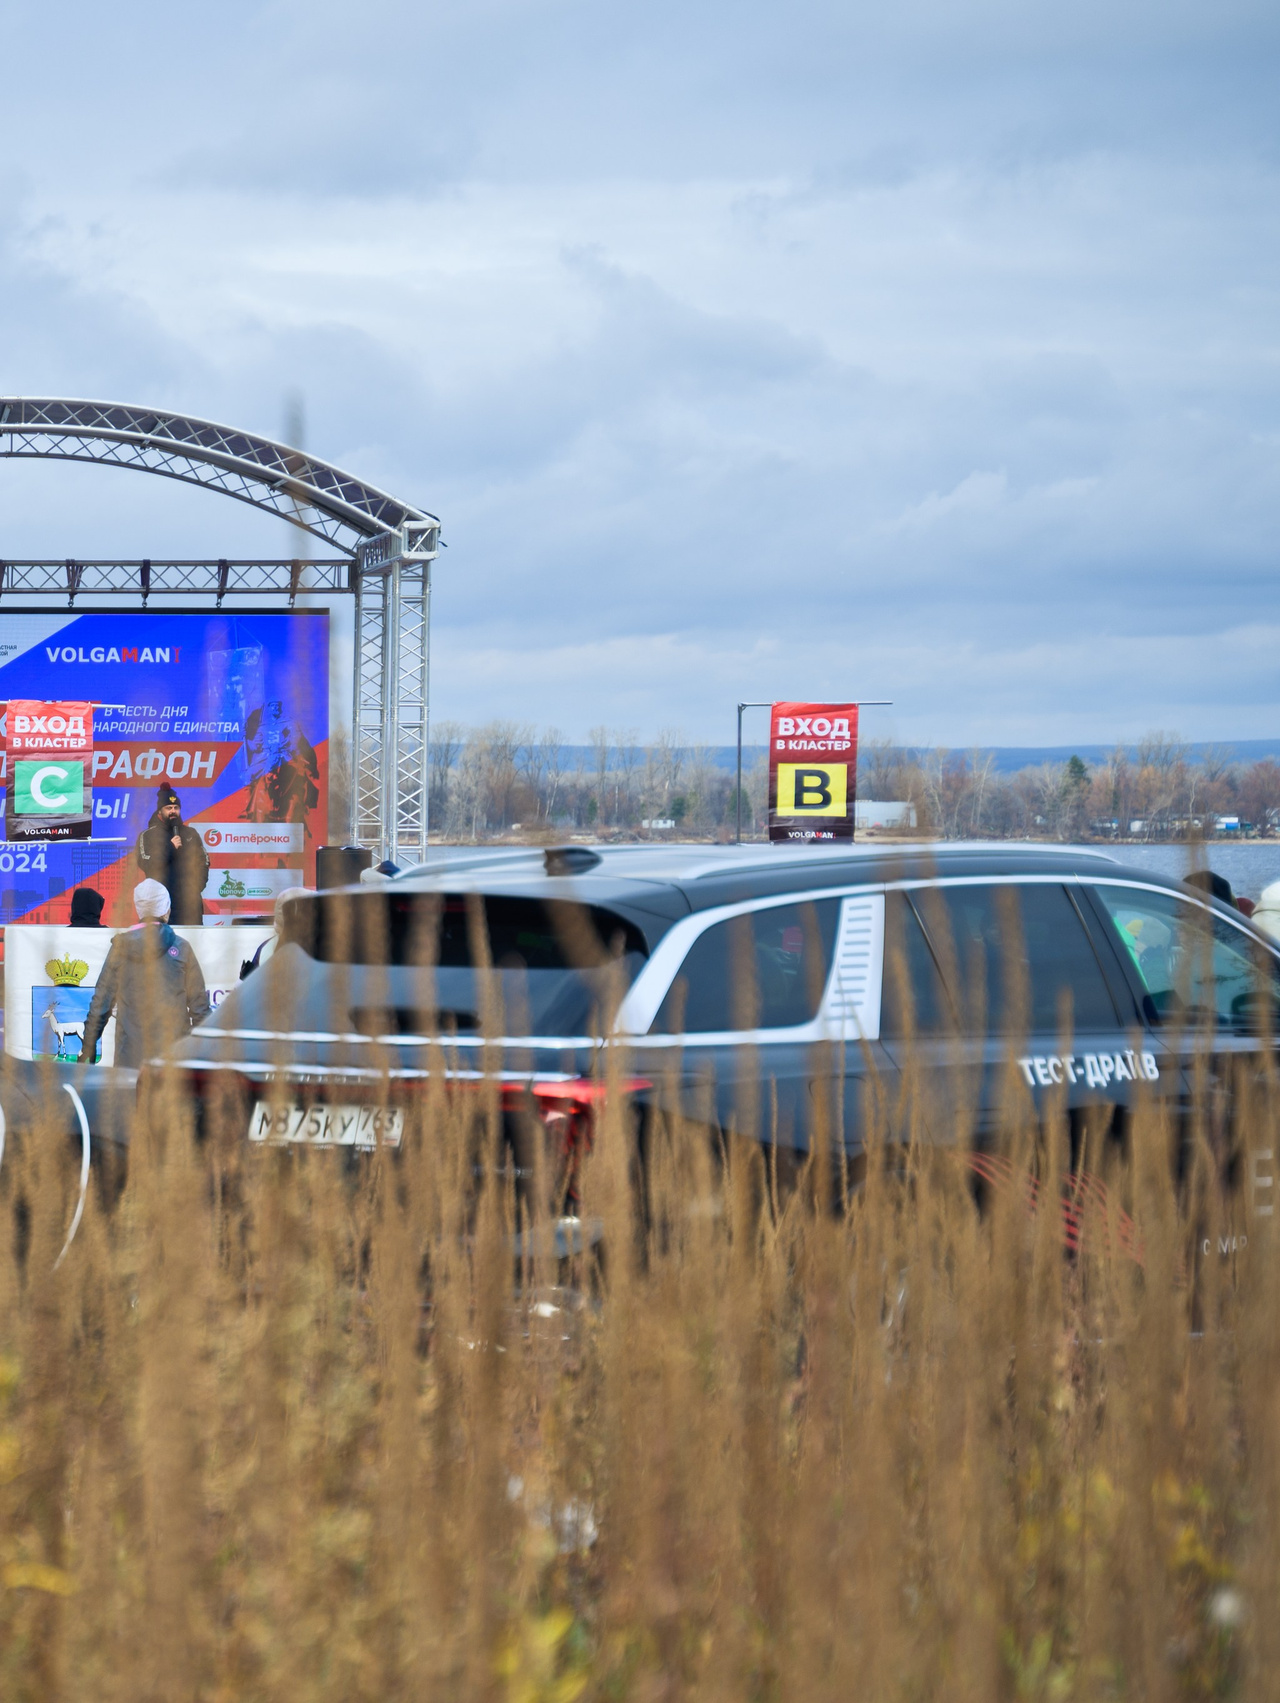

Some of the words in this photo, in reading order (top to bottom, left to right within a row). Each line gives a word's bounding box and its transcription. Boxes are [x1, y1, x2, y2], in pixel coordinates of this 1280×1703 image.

[46, 647, 170, 663] VOLGAMAN
[104, 706, 113, 716] В
[117, 705, 157, 717] ЧЕСТЬ
[160, 705, 188, 719] ДНЯ
[14, 716, 86, 737] ВХОД
[93, 721, 170, 735] НАРОДНОГО
[173, 721, 240, 735] ЕДИНСТВА
[778, 717, 851, 739] ВХОД
[13, 737, 22, 747] В
[25, 738, 87, 748] КЛАСТЕР
[776, 740, 786, 749] В
[789, 740, 852, 750] КЛАСТЕР
[30, 766, 69, 808] C
[794, 769, 832, 810] B
[225, 833, 290, 845] Пятёрочка
[1018, 1050, 1160, 1088] ТЕСТ-ДРАЙВ
